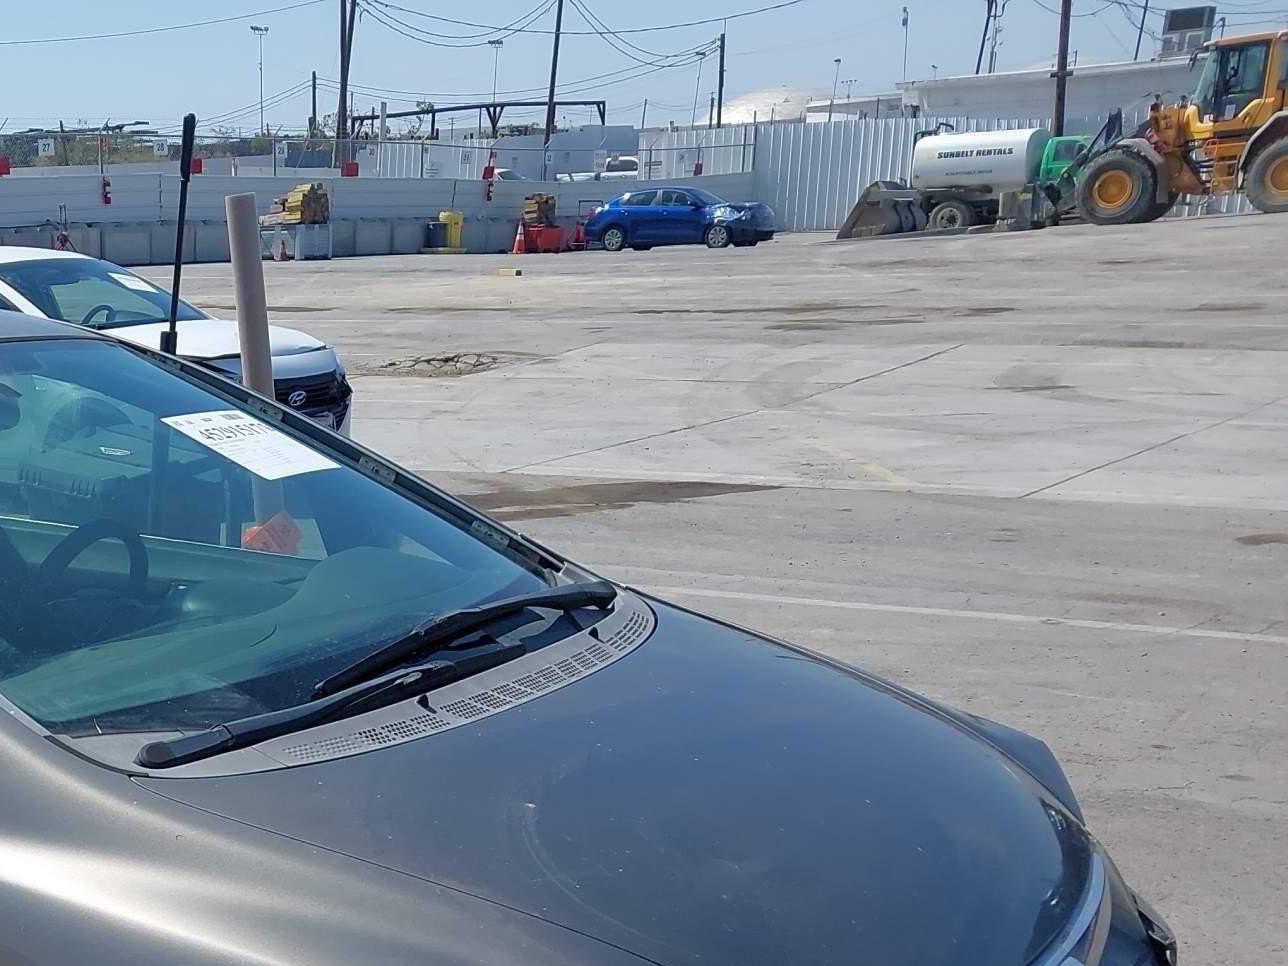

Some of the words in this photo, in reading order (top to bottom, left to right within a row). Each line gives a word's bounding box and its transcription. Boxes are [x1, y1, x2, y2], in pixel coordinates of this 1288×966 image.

[42, 143, 50, 152] 27
[937, 150, 974, 159] SUNBELT
[976, 147, 1014, 156] RENTALS
